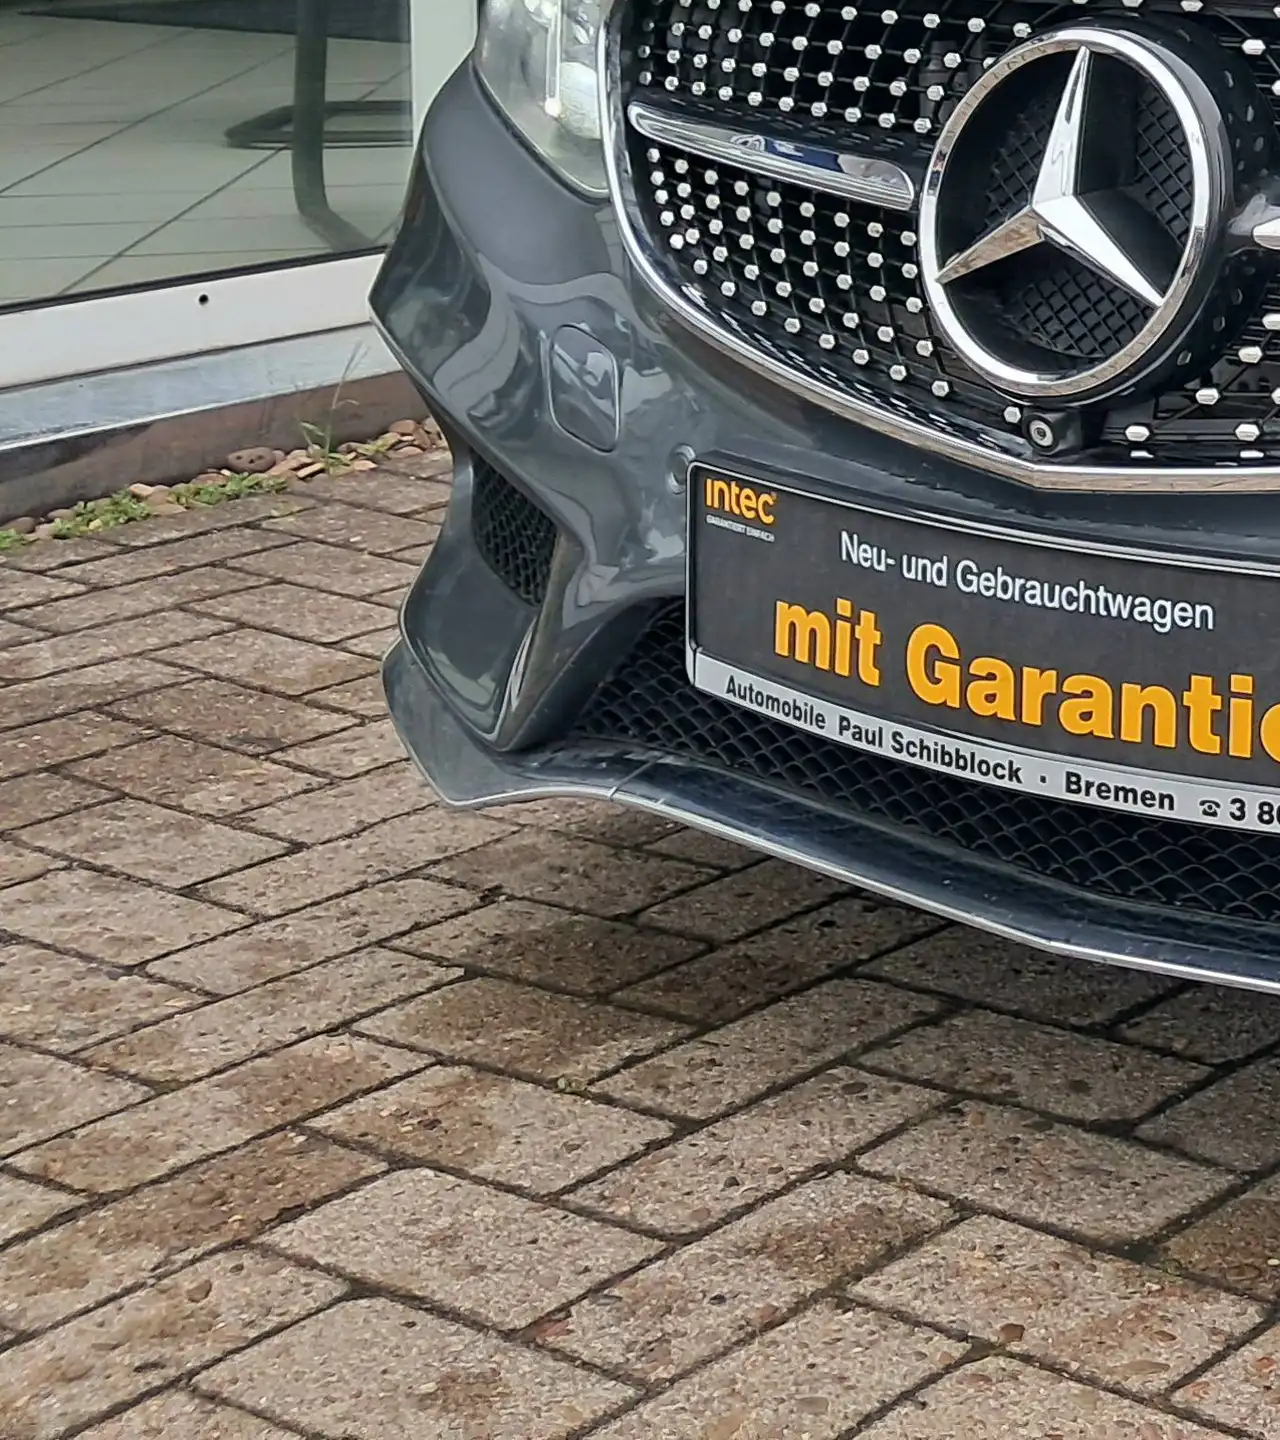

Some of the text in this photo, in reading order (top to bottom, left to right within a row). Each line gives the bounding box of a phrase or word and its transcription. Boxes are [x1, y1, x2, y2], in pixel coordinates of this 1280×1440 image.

[840, 530, 1215, 633] Neu- und Gebrauchtwagen
[774, 598, 882, 686] mit
[725, 674, 827, 730] Automobile
[838, 715, 883, 749] Paul
[890, 730, 1023, 784] Schibblock
[1065, 770, 1175, 811] Bremen
[1229, 797, 1246, 822] 3
